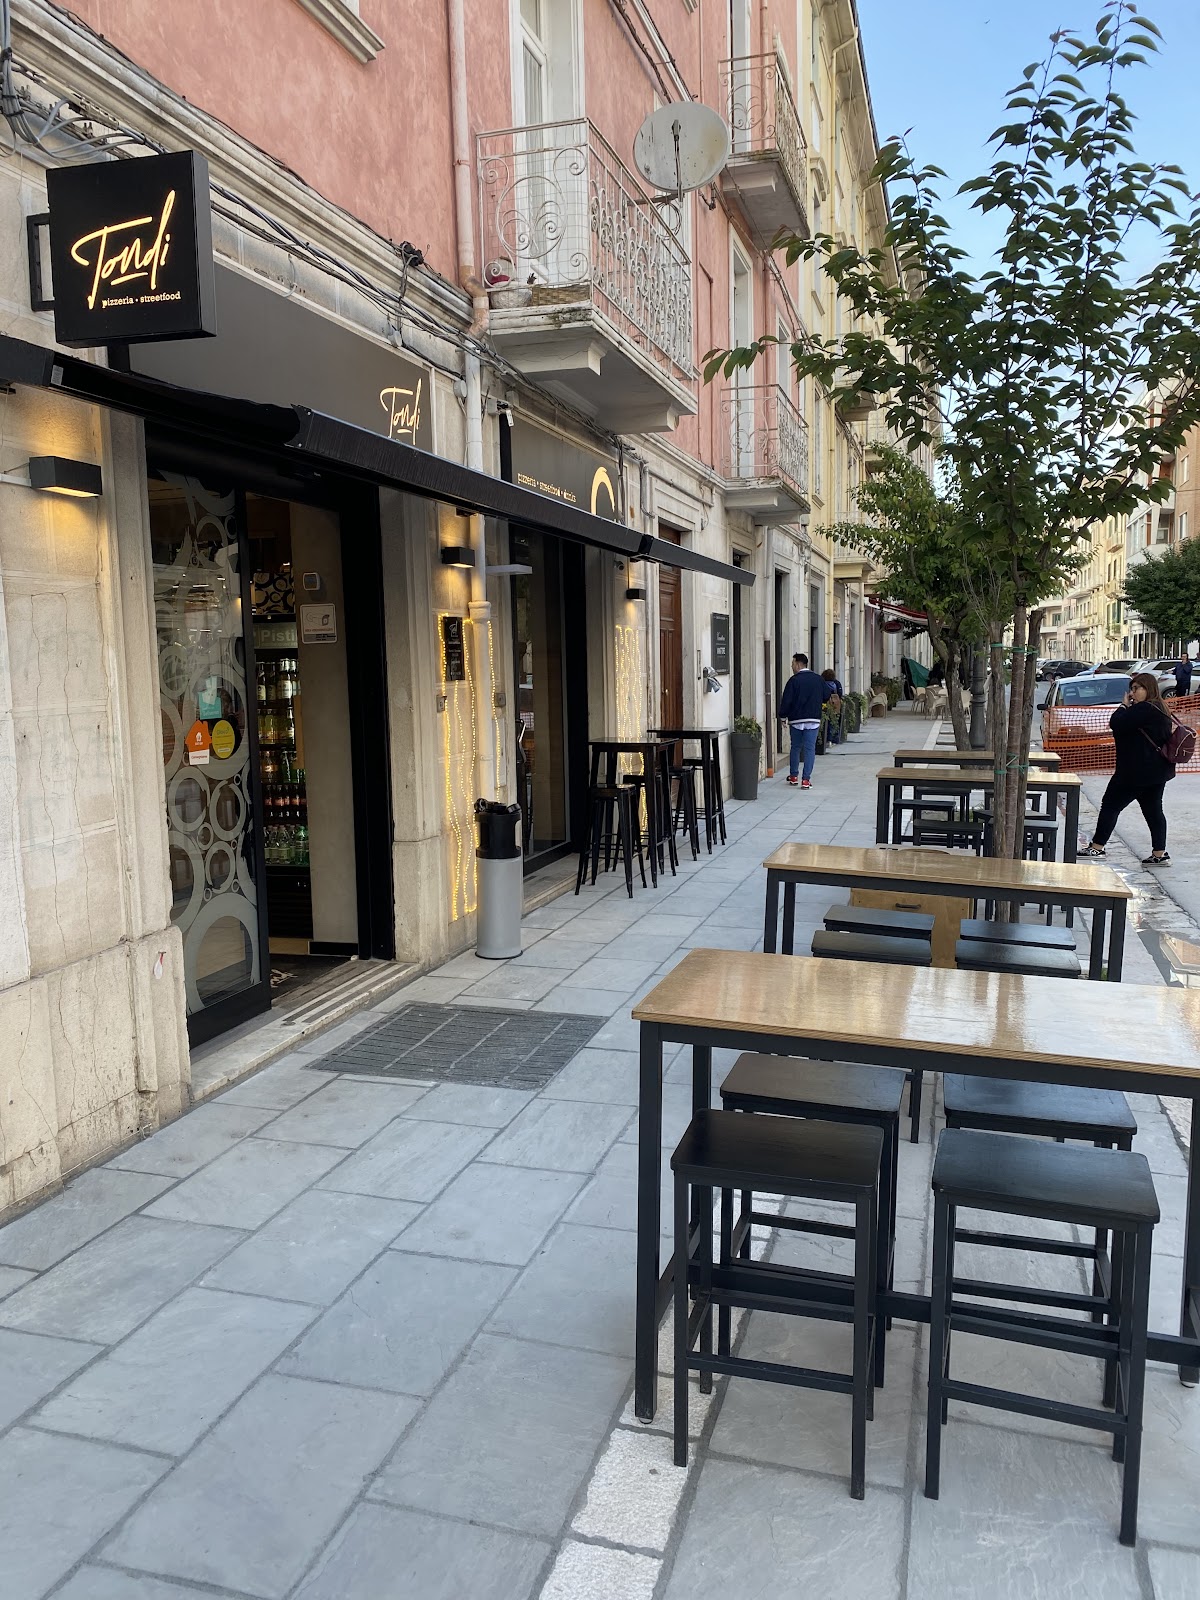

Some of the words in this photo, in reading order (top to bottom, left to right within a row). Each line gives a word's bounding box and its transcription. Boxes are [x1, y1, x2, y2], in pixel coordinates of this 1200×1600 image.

[70, 189, 176, 310] Tondi
[101, 295, 134, 309] pizzeria
[140, 290, 182, 304] streetfood
[379, 378, 422, 446] Tondi
